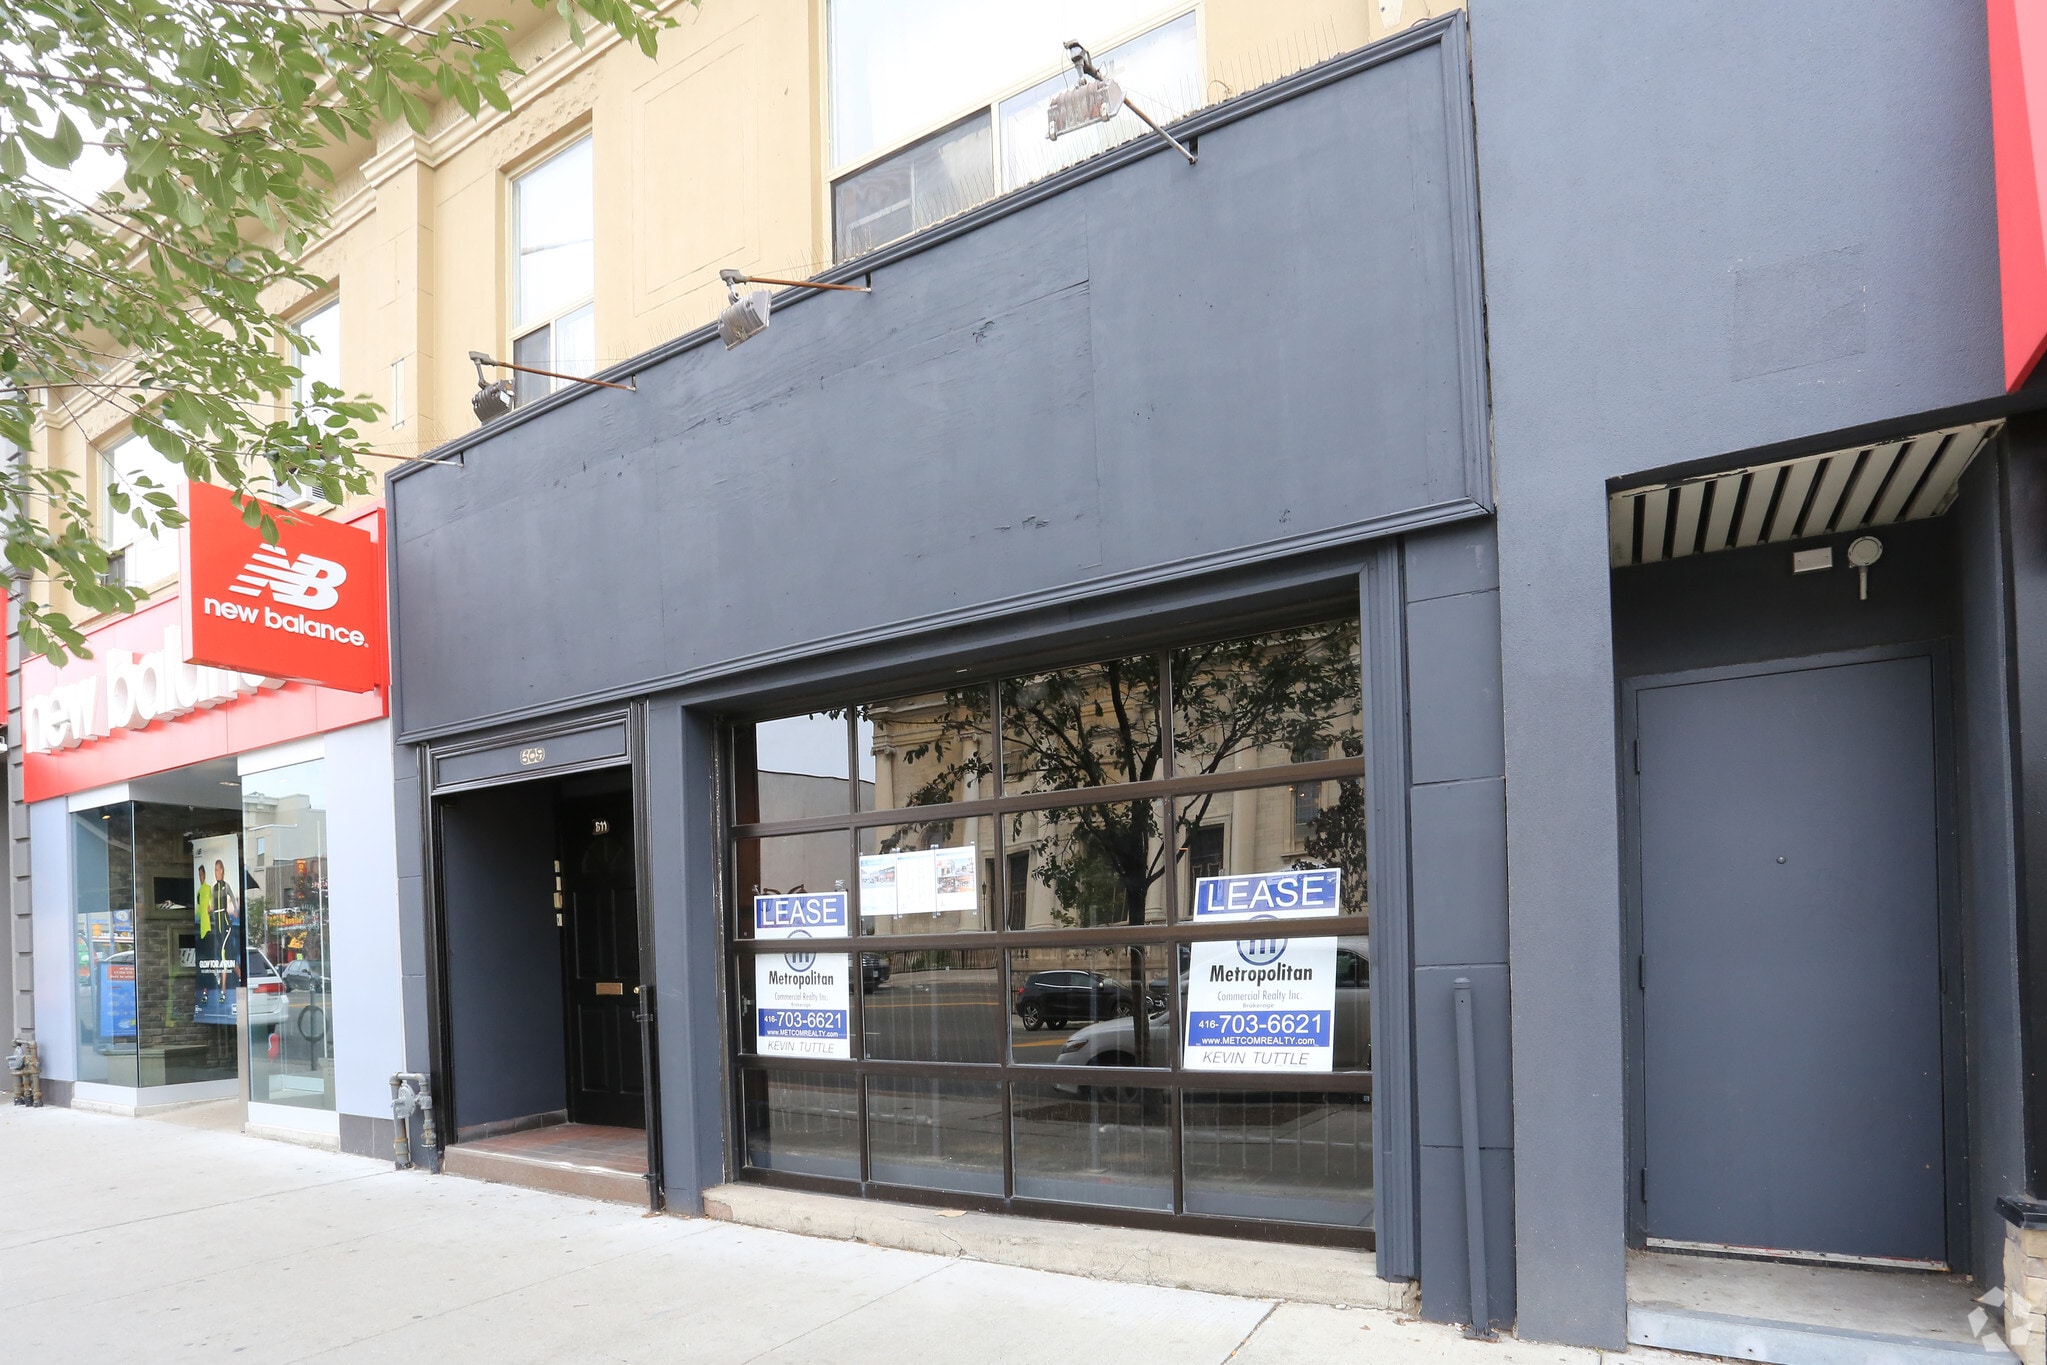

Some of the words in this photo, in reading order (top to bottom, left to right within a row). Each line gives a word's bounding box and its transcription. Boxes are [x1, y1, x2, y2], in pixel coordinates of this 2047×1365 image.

[204, 597, 259, 624] new
[26, 675, 103, 753] new
[1207, 876, 1325, 911] LEASE
[761, 898, 838, 925] LEASE
[769, 970, 834, 989] Metropolitan
[1209, 962, 1313, 986] Metropolitan
[775, 992, 801, 1000] Commercial
[803, 992, 818, 1001] Realty
[819, 993, 828, 1001] Inc.
[1217, 990, 1260, 1001] Commercial
[1262, 990, 1285, 1002] Realty
[1289, 990, 1302, 1000] Inc.
[767, 1029, 838, 1037] www.METCOMREALTY.com
[1202, 1036, 1315, 1045] www.METCOMREALTY.com
[768, 1040, 795, 1051] KEVIN
[800, 1041, 835, 1054] TUTTLE
[1203, 1051, 1247, 1064] KEVIN
[1252, 1051, 1309, 1065] TUTTLE
